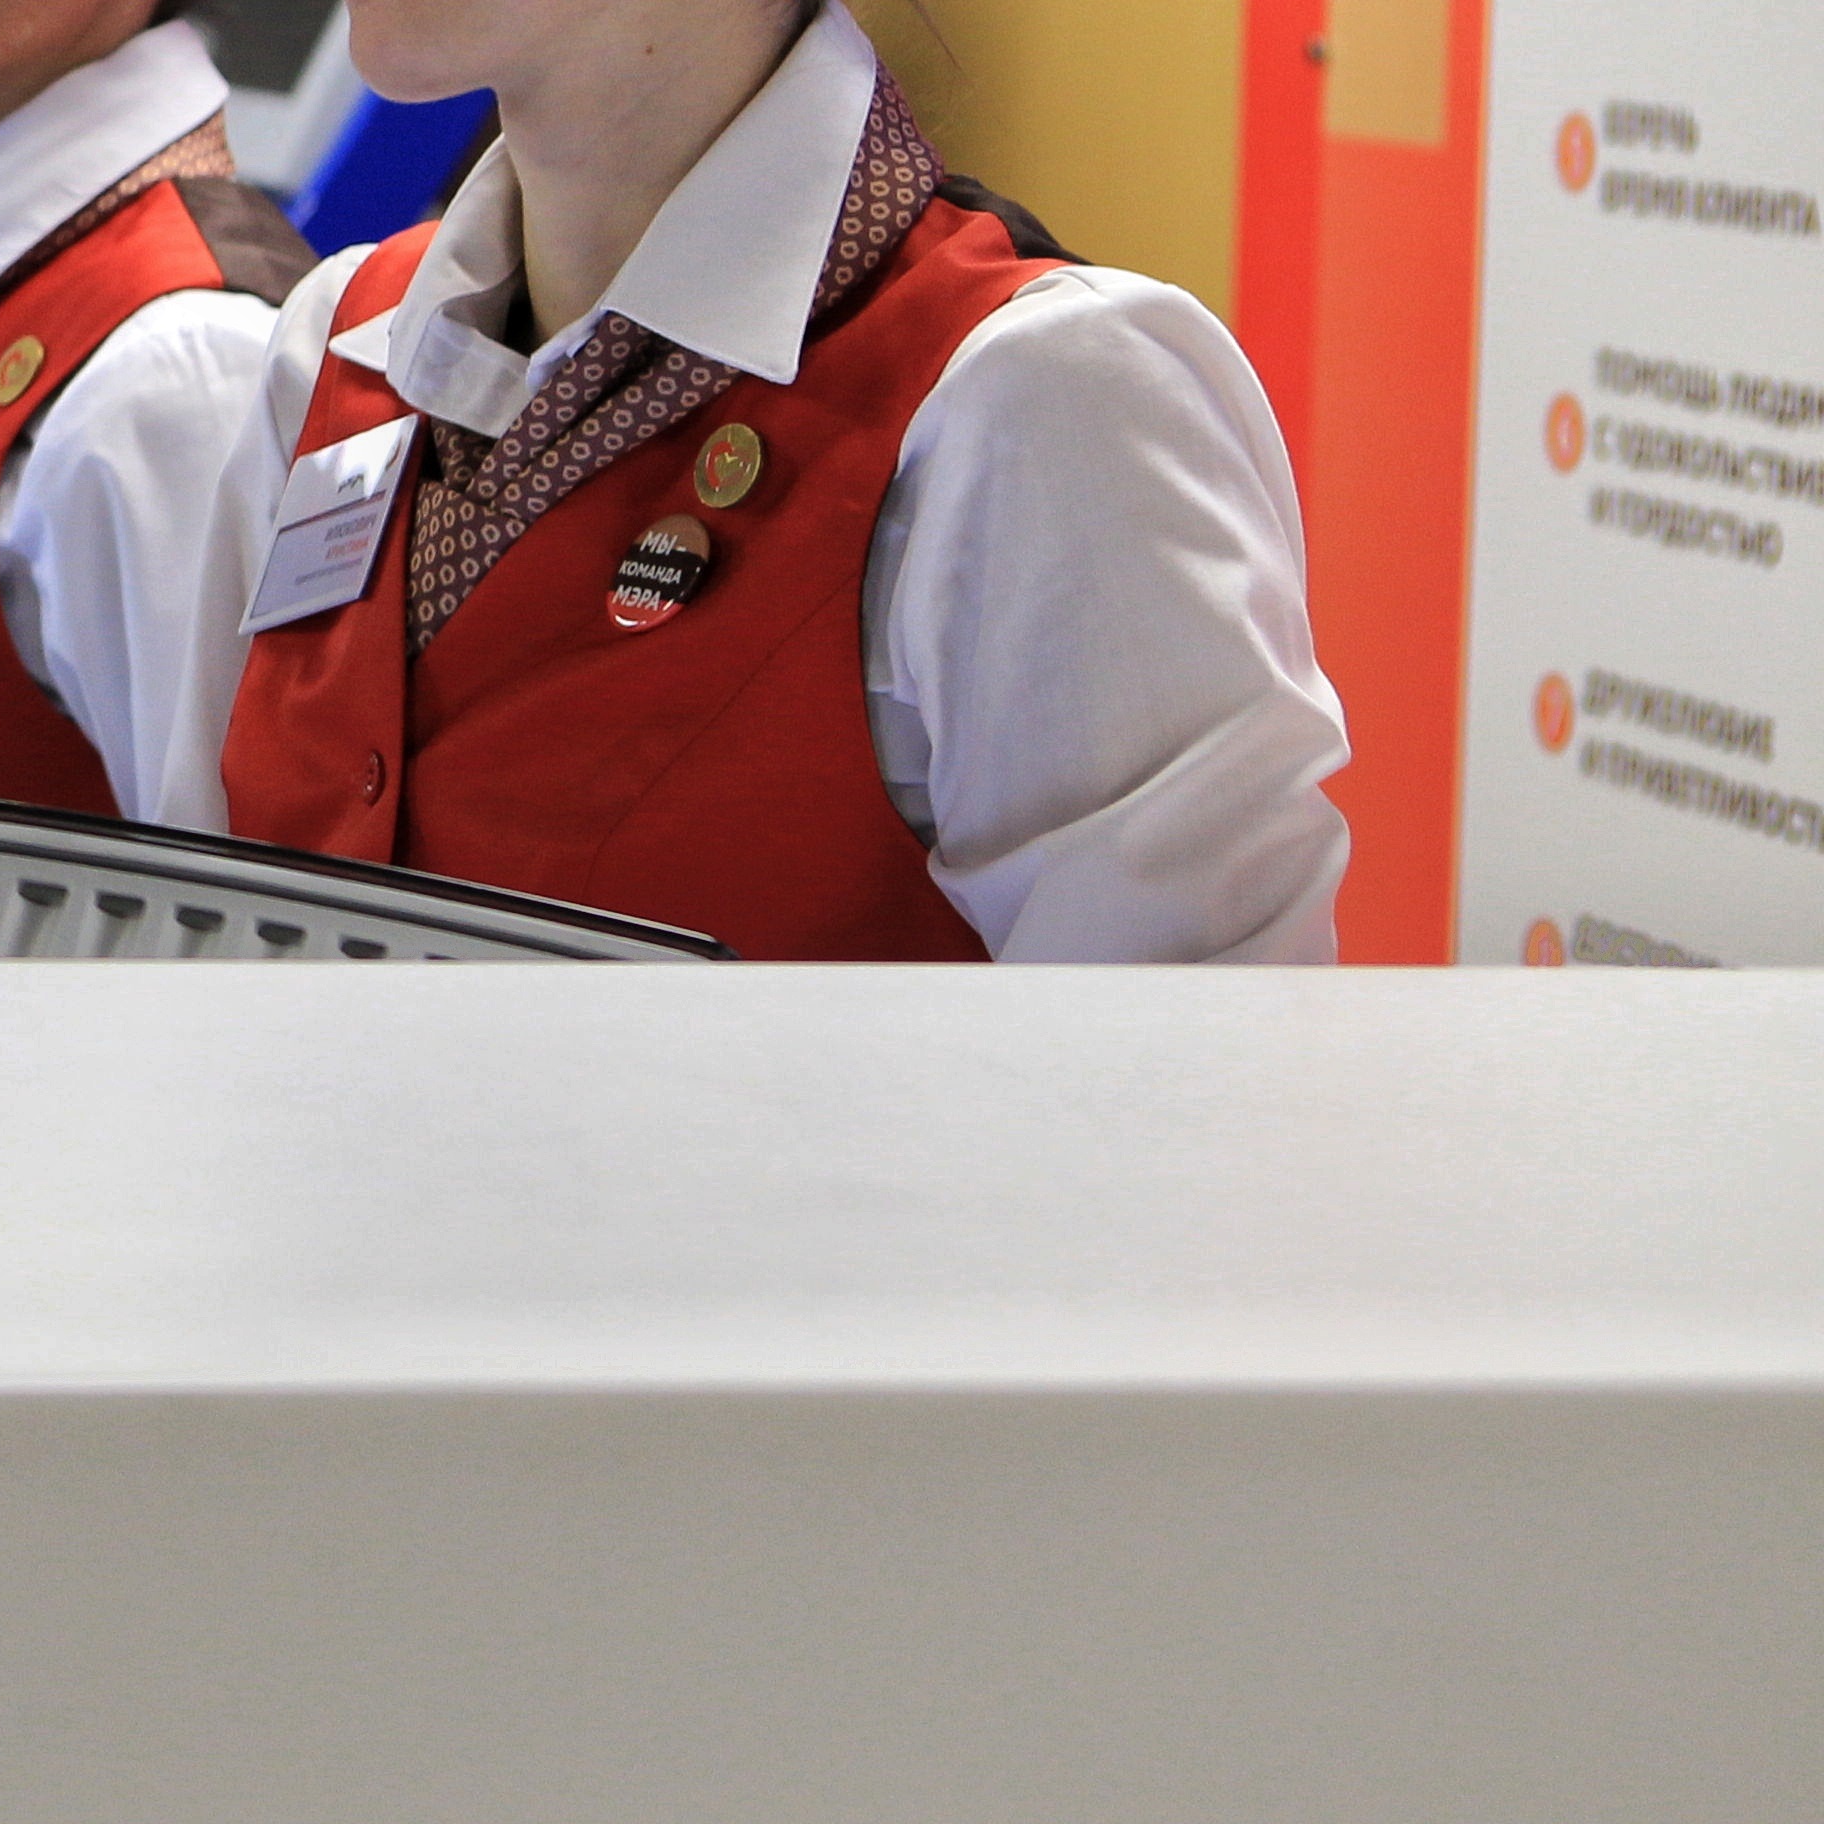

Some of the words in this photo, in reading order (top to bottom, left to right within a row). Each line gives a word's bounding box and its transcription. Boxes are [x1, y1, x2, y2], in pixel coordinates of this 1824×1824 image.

[639, 530, 678, 555] МЫ
[618, 559, 682, 584] КОМАНДА
[612, 584, 662, 611] МЭРА
